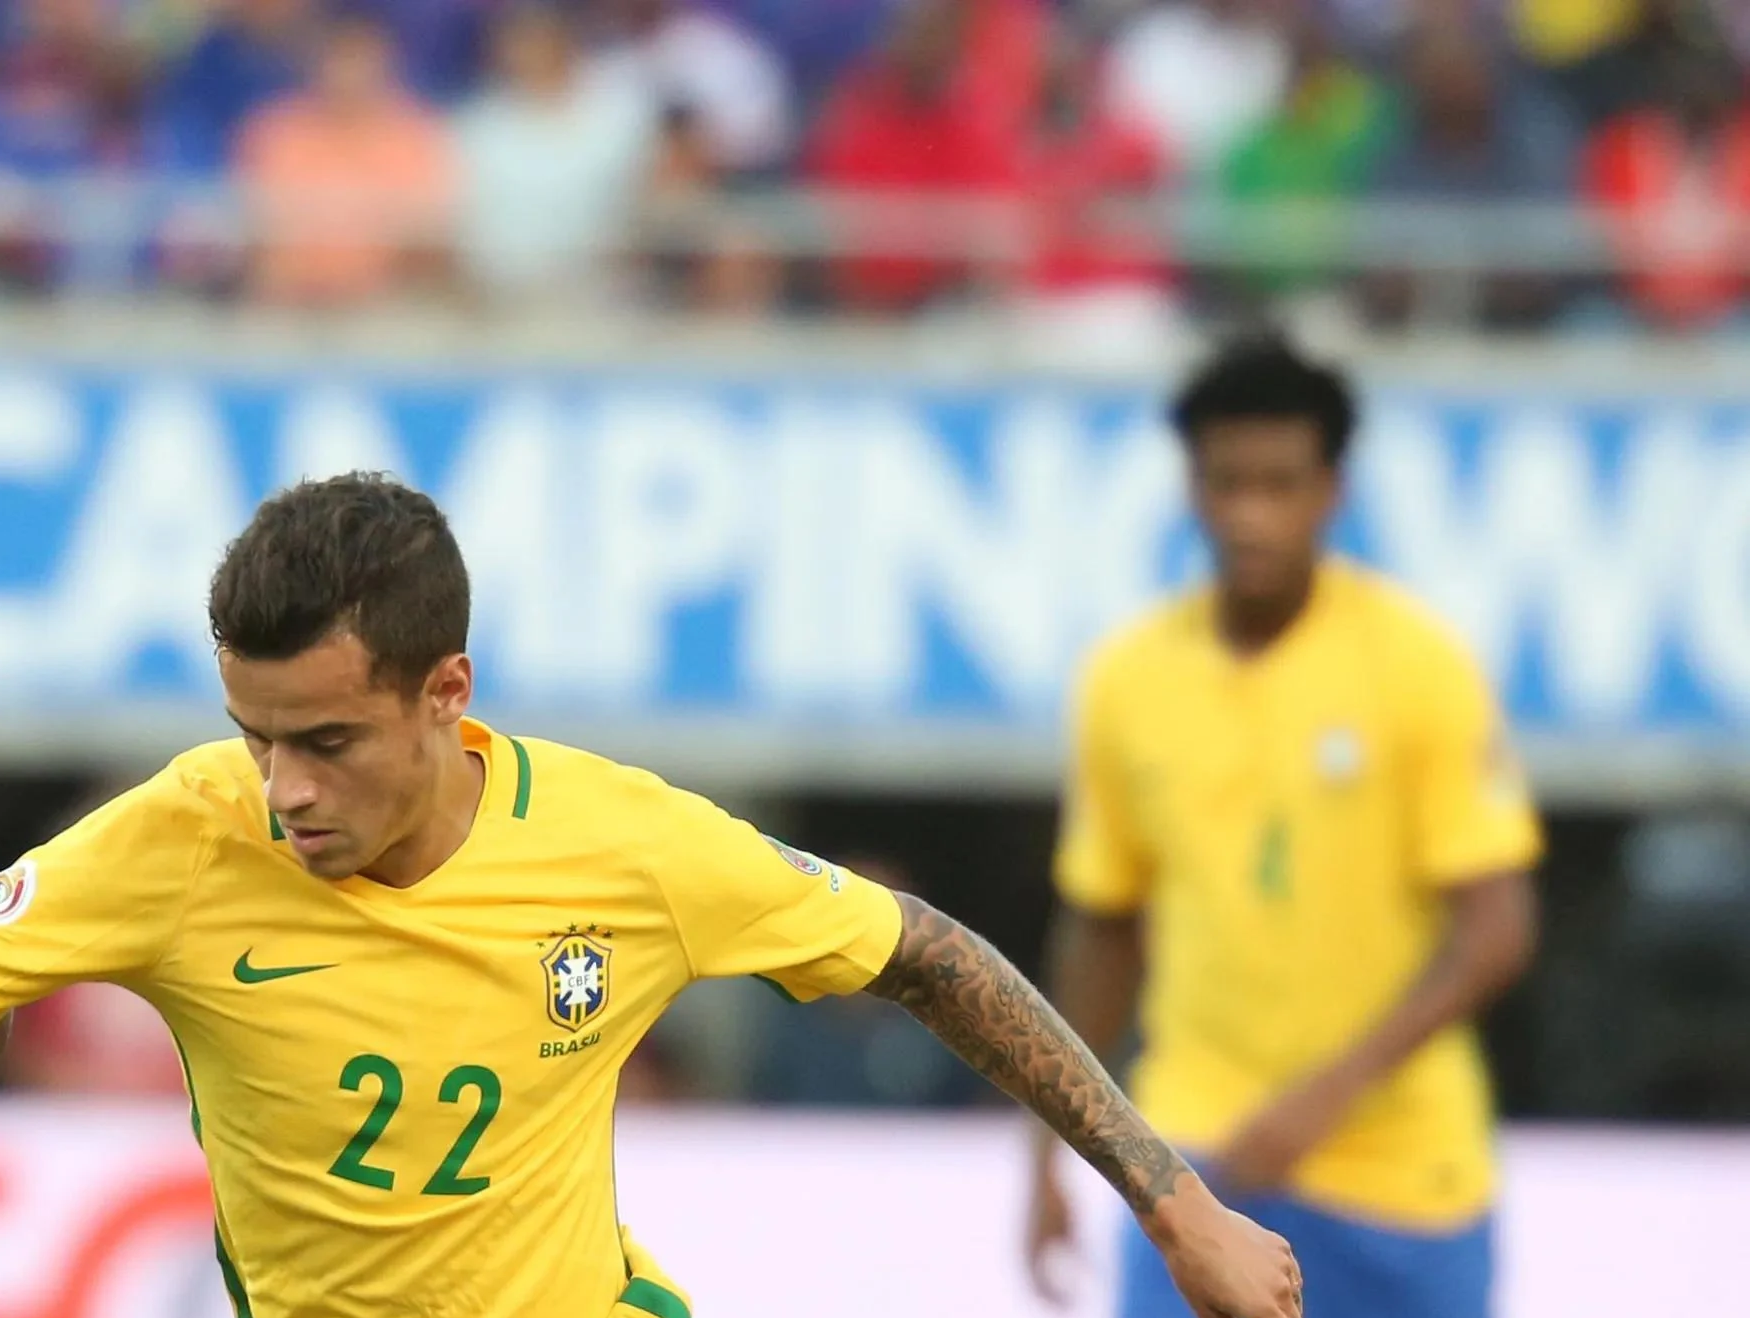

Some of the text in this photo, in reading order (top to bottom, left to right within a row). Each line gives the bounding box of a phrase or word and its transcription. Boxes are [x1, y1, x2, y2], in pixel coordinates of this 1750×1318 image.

[1362, 398, 1750, 706] W
[567, 973, 591, 988] CBF
[327, 1053, 502, 1196] 22
